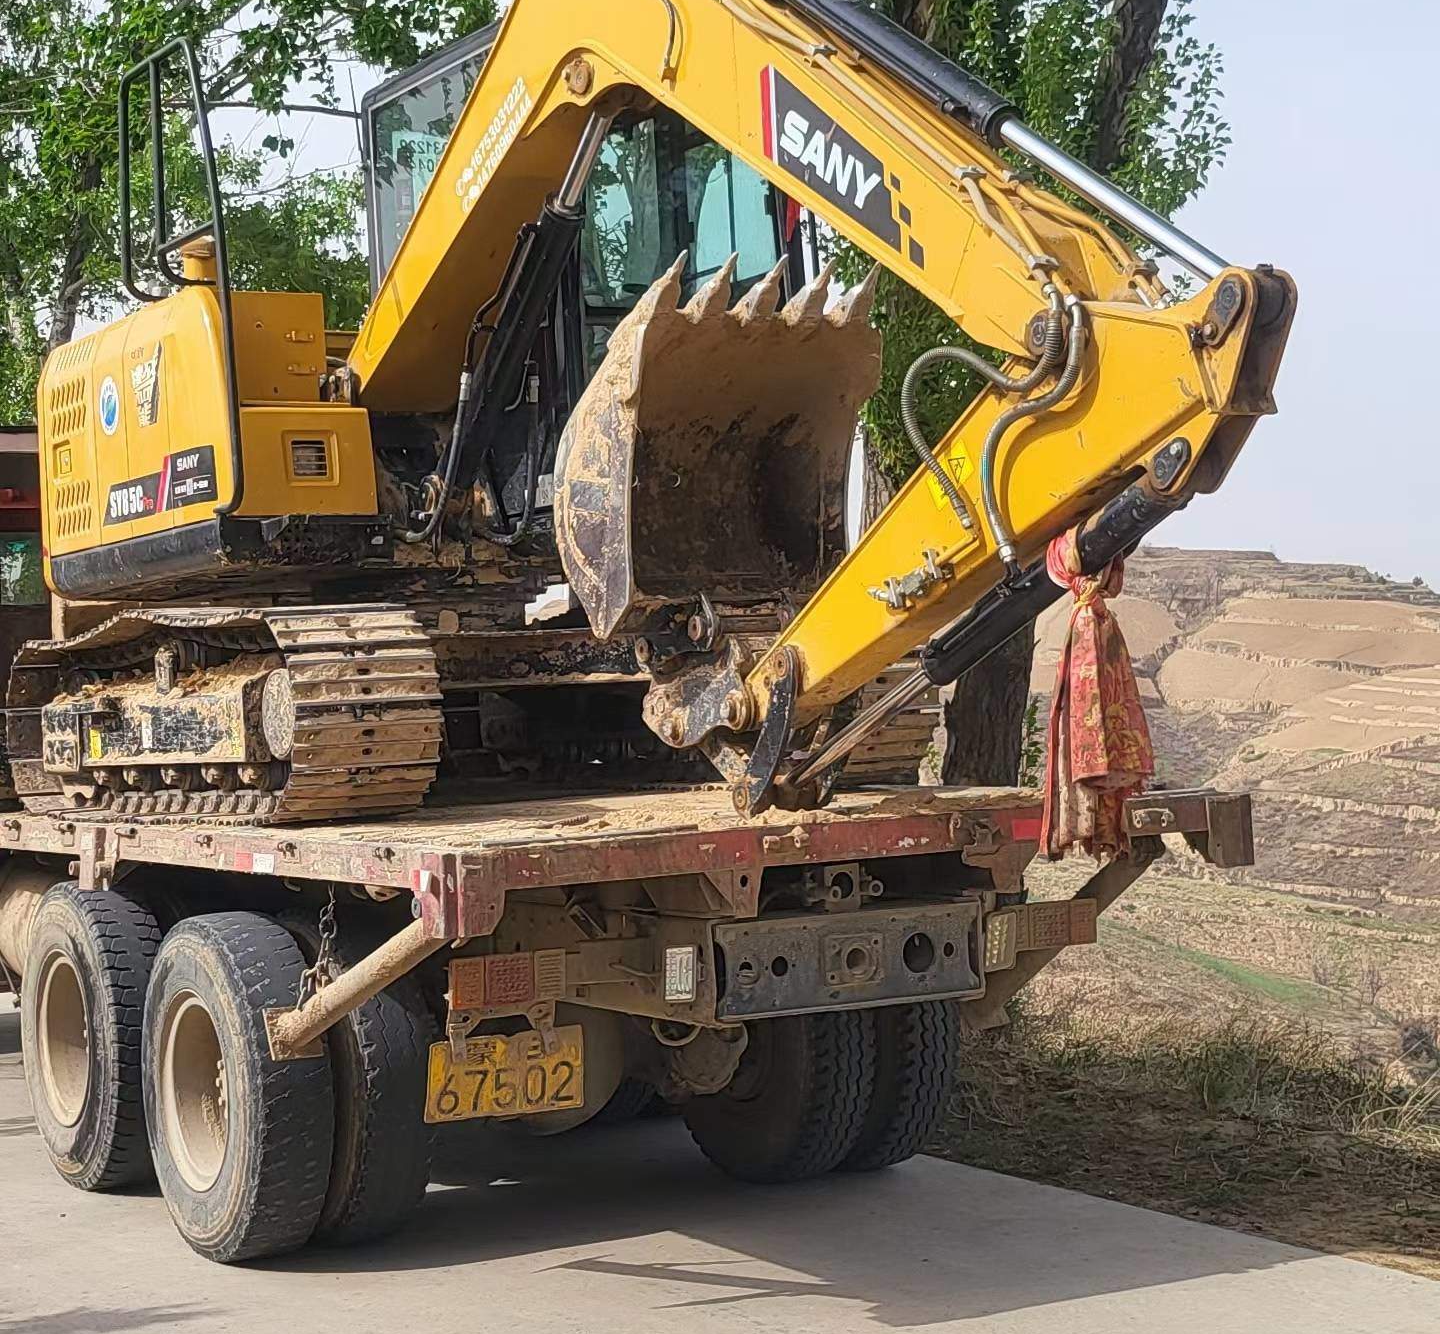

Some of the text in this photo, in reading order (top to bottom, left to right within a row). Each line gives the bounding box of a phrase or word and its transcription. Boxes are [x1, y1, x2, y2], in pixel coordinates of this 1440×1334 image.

[779, 110, 882, 210] SANY
[176, 453, 200, 472] SANY
[109, 485, 144, 519] SY85C
[436, 1060, 574, 1115] 67502
